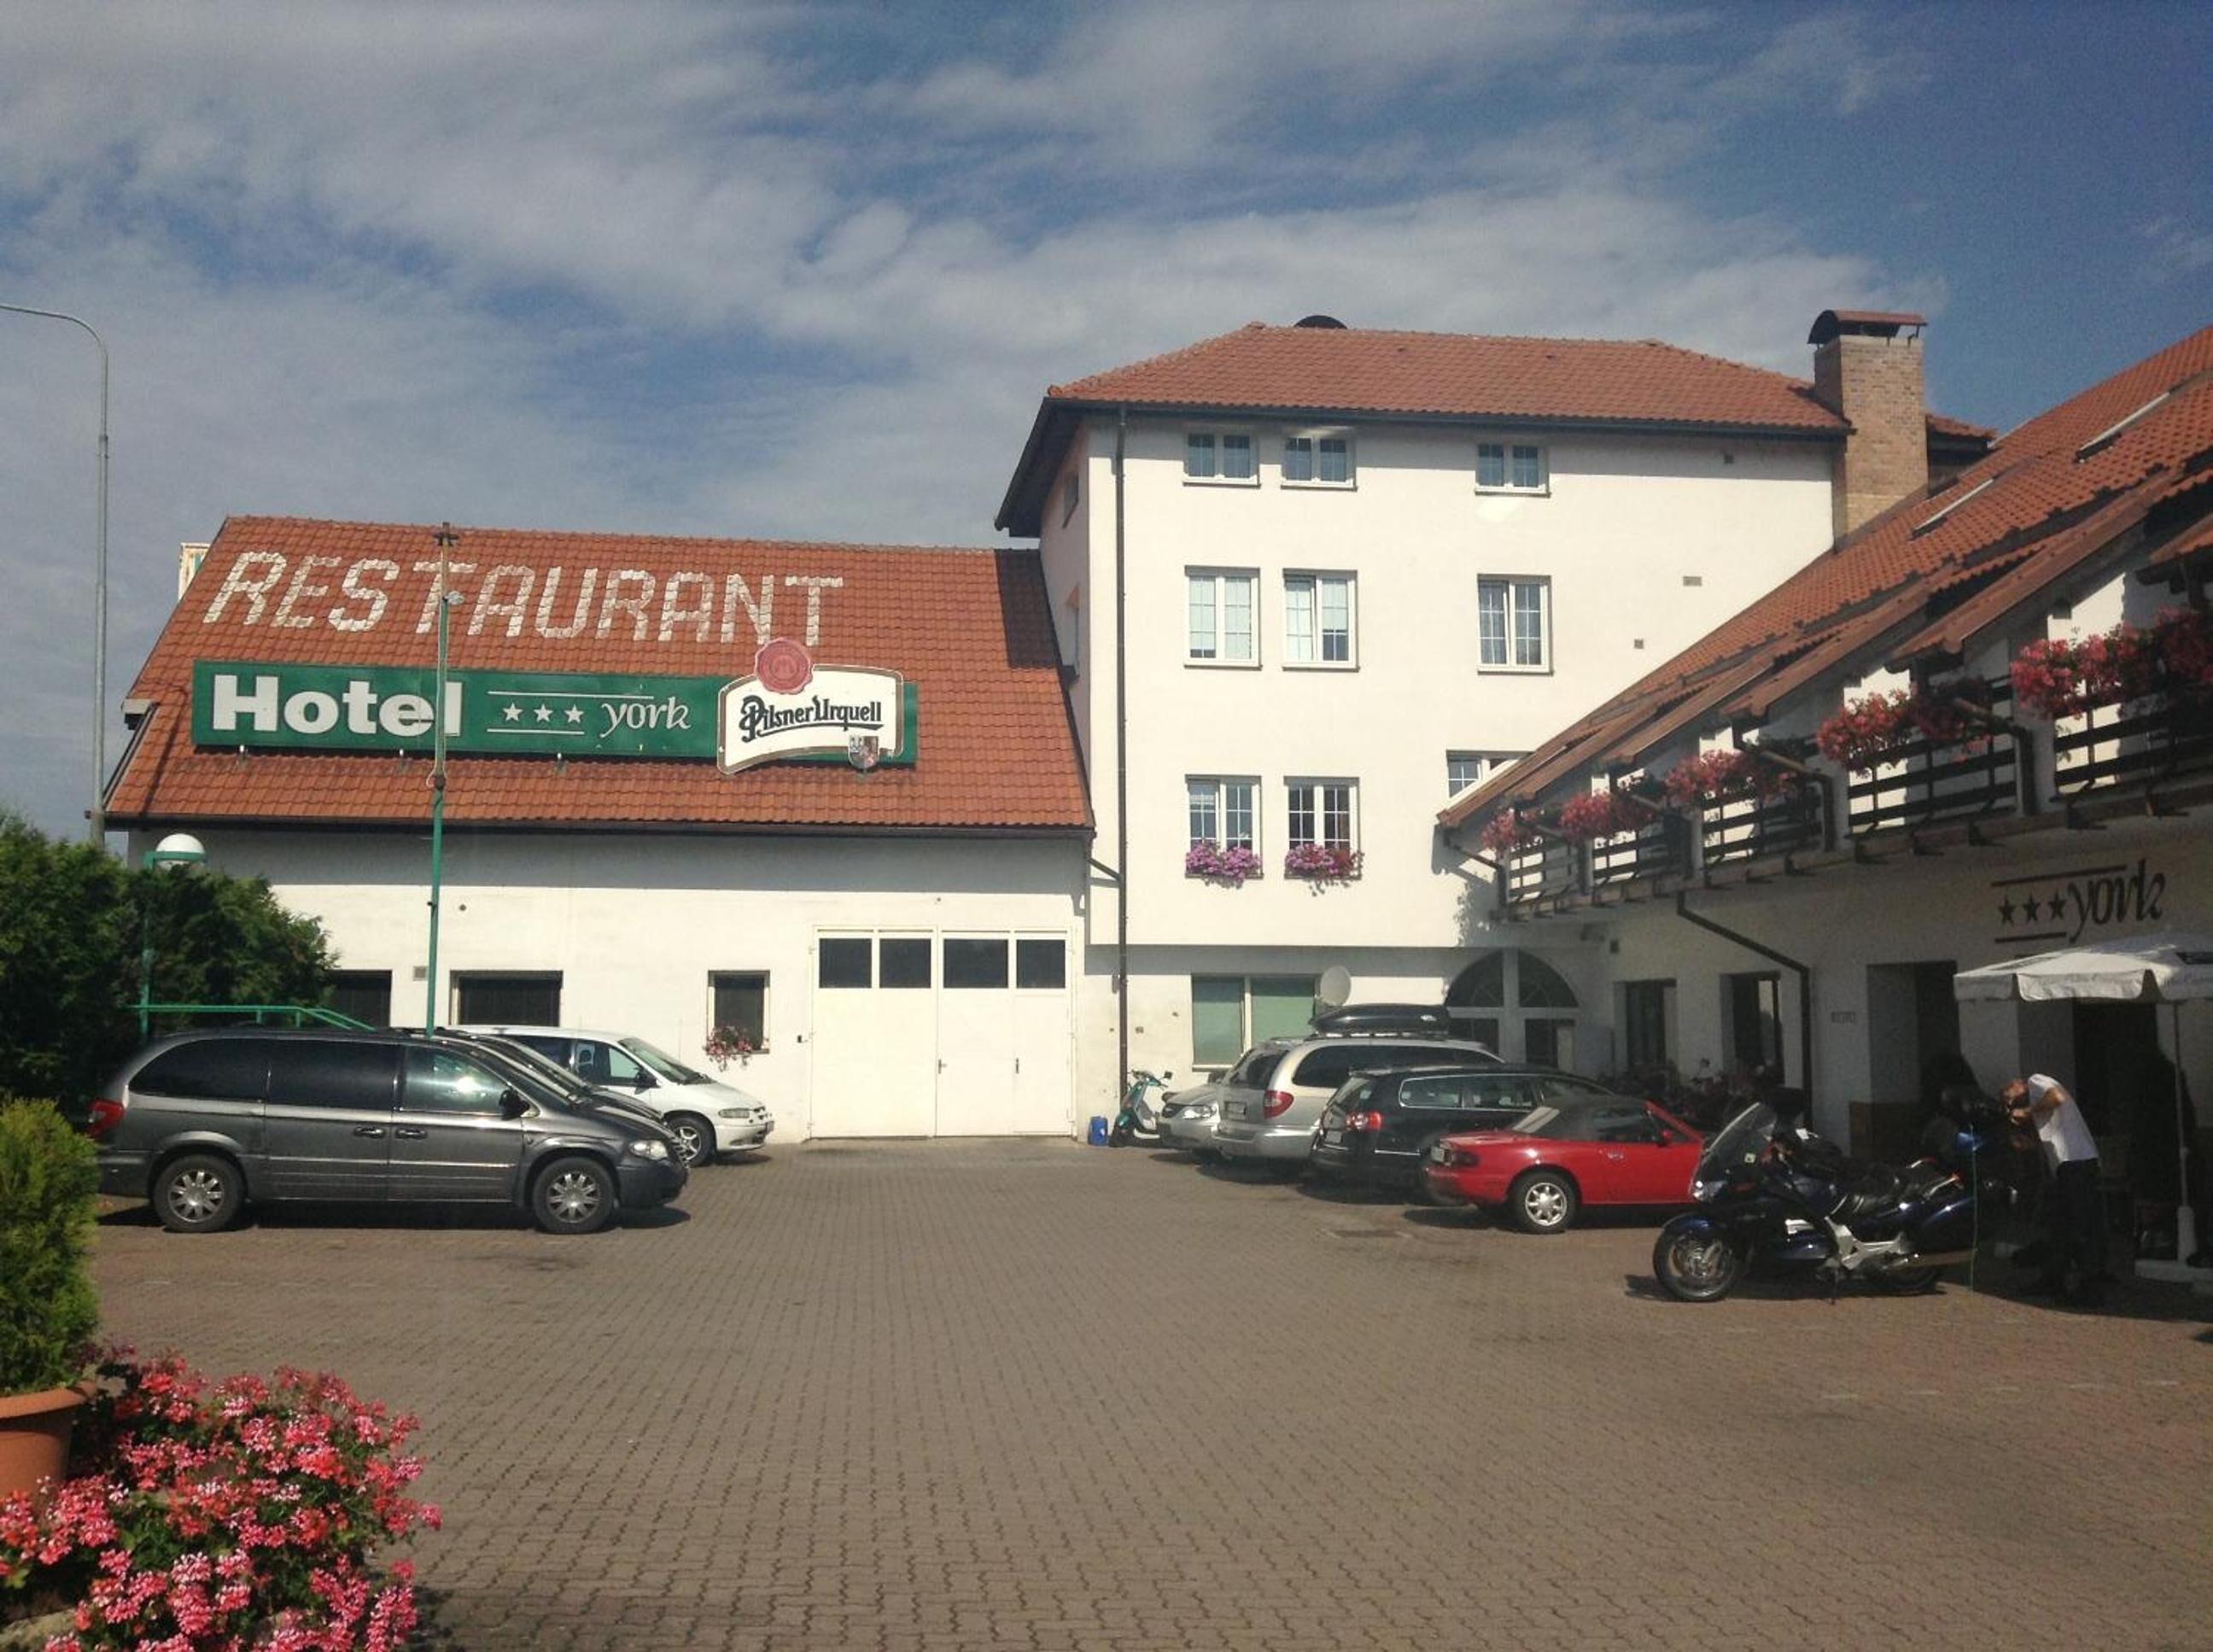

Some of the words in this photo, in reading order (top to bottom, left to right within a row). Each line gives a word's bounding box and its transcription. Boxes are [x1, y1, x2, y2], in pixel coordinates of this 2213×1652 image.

[203, 551, 844, 646] RESTAURANT
[213, 675, 462, 738] Hotel
[600, 696, 691, 738] york
[739, 694, 813, 742] Pilsner
[812, 695, 881, 732] Urquell
[2067, 857, 2165, 943] york
